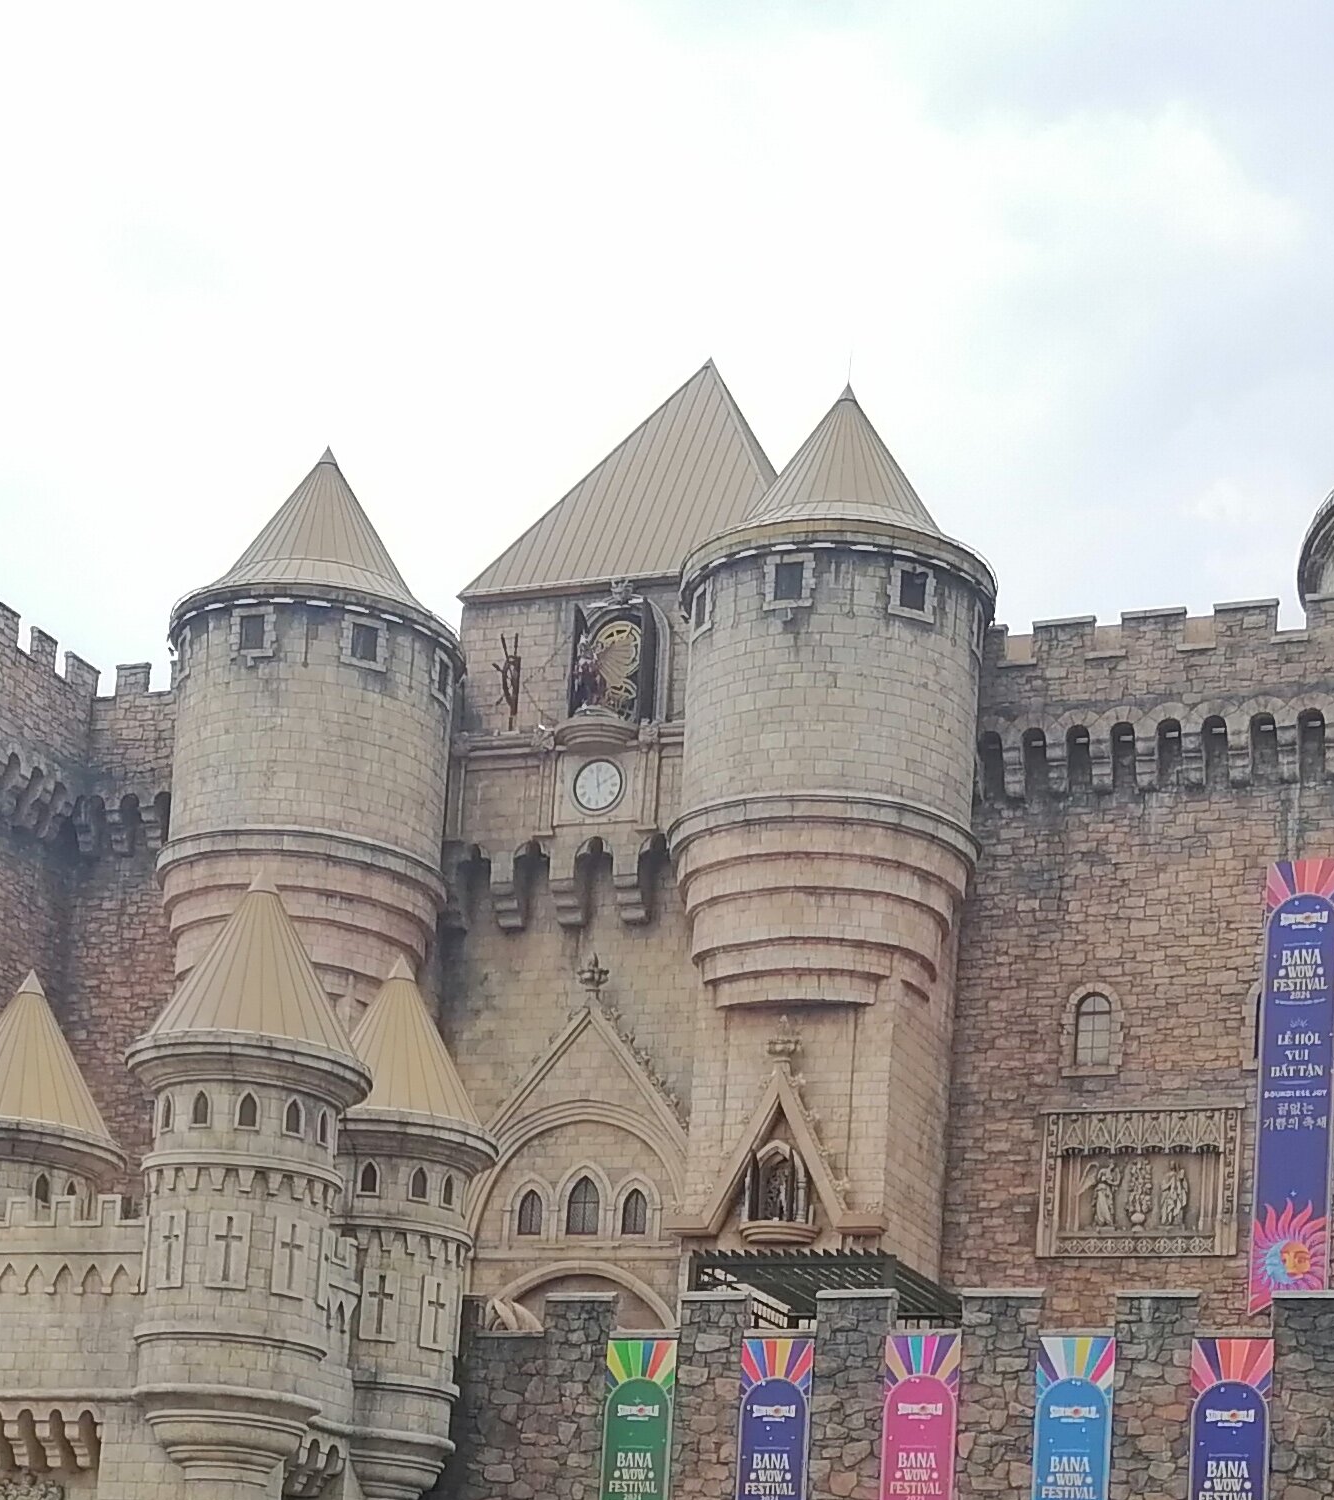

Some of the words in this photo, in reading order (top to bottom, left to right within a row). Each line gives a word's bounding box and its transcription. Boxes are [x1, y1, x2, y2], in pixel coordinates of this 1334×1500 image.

[1282, 949, 1321, 966] BANA
[1288, 966, 1315, 978] WOW
[1274, 977, 1328, 992] FESTIVAL
[1285, 1049, 1309, 1061] VUI
[616, 1452, 652, 1468] BANA
[753, 1453, 789, 1469] BANA
[898, 1452, 936, 1468] BANA
[1050, 1456, 1090, 1472] BANA
[621, 1469, 647, 1480] WOW
[758, 1470, 783, 1482] WOW
[903, 1469, 930, 1481] WOW
[1207, 1461, 1249, 1478] BANA
[1056, 1473, 1085, 1486] WOW
[1213, 1479, 1243, 1491] WOW
[608, 1480, 657, 1493] FESTIVAL
[745, 1483, 795, 1495] FESTIVAL
[890, 1482, 942, 1494] FESTIVAL
[1042, 1486, 1096, 1500] FESTIVAL
